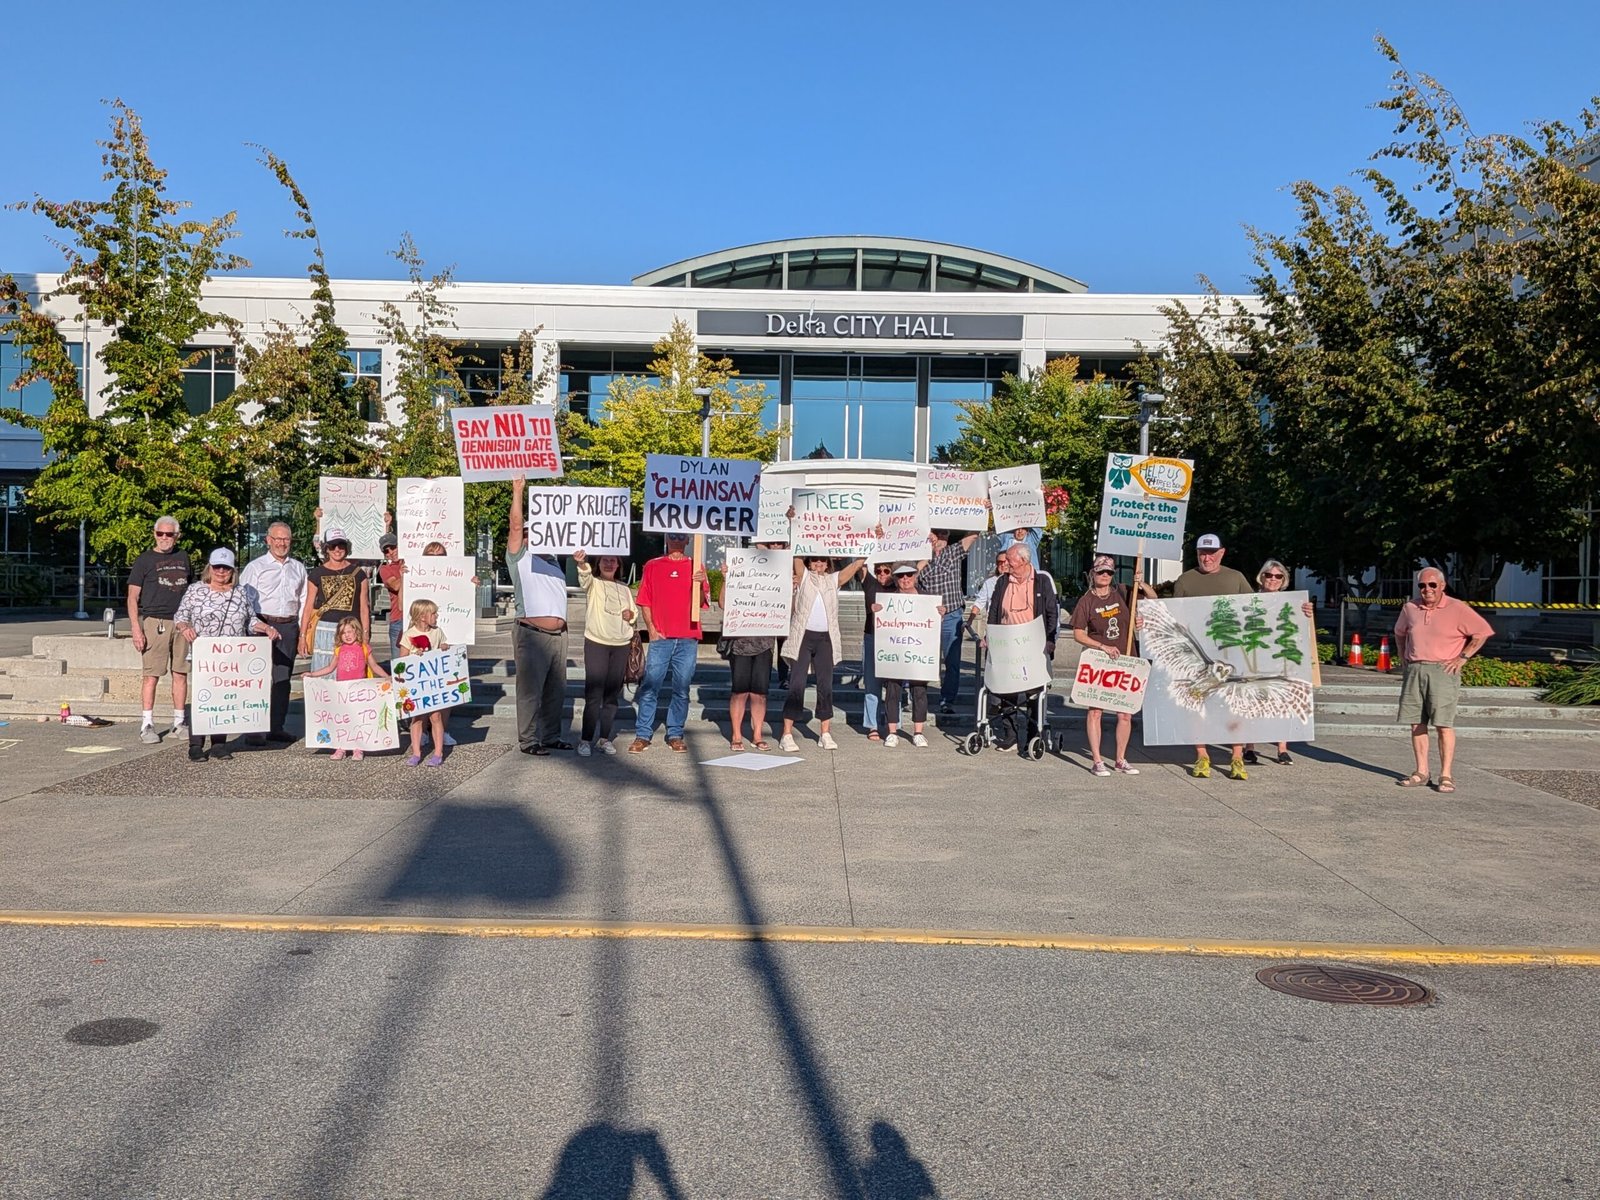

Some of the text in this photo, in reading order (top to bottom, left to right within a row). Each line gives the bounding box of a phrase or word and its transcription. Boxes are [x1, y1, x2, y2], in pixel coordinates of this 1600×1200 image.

[766, 301, 955, 337] Delta CITY HALL
[457, 413, 552, 438] SAY NO TO
[461, 438, 553, 453] DENNISON GATE
[462, 452, 558, 471] TOWNHOUSES
[680, 460, 730, 476] DYLAN
[1139, 462, 1182, 483] HELP US
[326, 479, 378, 494] STOP
[651, 472, 760, 502] "CHAINSAW"
[928, 483, 960, 492] IS NOT
[531, 493, 628, 517] STOP KRUGER
[798, 492, 865, 511] TREES
[908, 502, 916, 512] IS
[927, 494, 987, 506] RESPONSIBL
[1111, 497, 1178, 513] Protect the
[403, 508, 447, 520] TREES IS
[649, 502, 755, 532] KRUGER
[758, 512, 784, 520] BEHIN
[803, 512, 855, 522] filter air
[888, 515, 915, 527] HOME
[1110, 509, 1177, 524] Urban Forests
[415, 521, 441, 532] NOT
[804, 522, 831, 532] cool
[1108, 525, 1175, 541] Tsawwassen
[1136, 521, 1148, 530] of
[531, 521, 629, 548] SAVE DELTA
[801, 531, 842, 542] improve
[846, 528, 876, 540] menta
[898, 529, 921, 540] BACK
[794, 543, 817, 555] ALL
[823, 539, 863, 548] health
[731, 555, 768, 566] NO TO
[445, 566, 464, 578] HIGH
[439, 583, 451, 592] IN
[886, 597, 913, 614] ANY
[876, 616, 935, 630] Development
[212, 643, 257, 654] NO TO
[889, 636, 923, 646] NEEDS
[877, 649, 935, 665] GREEN SPACE
[198, 660, 240, 673] HIGH
[405, 655, 451, 681] SAVE
[418, 677, 445, 691] THE
[1077, 663, 1147, 695] EVICTED!
[312, 687, 377, 704] WE NEED
[412, 688, 460, 711] TREES
[314, 708, 377, 724] SPACE TO
[336, 726, 379, 744] PLAY!
